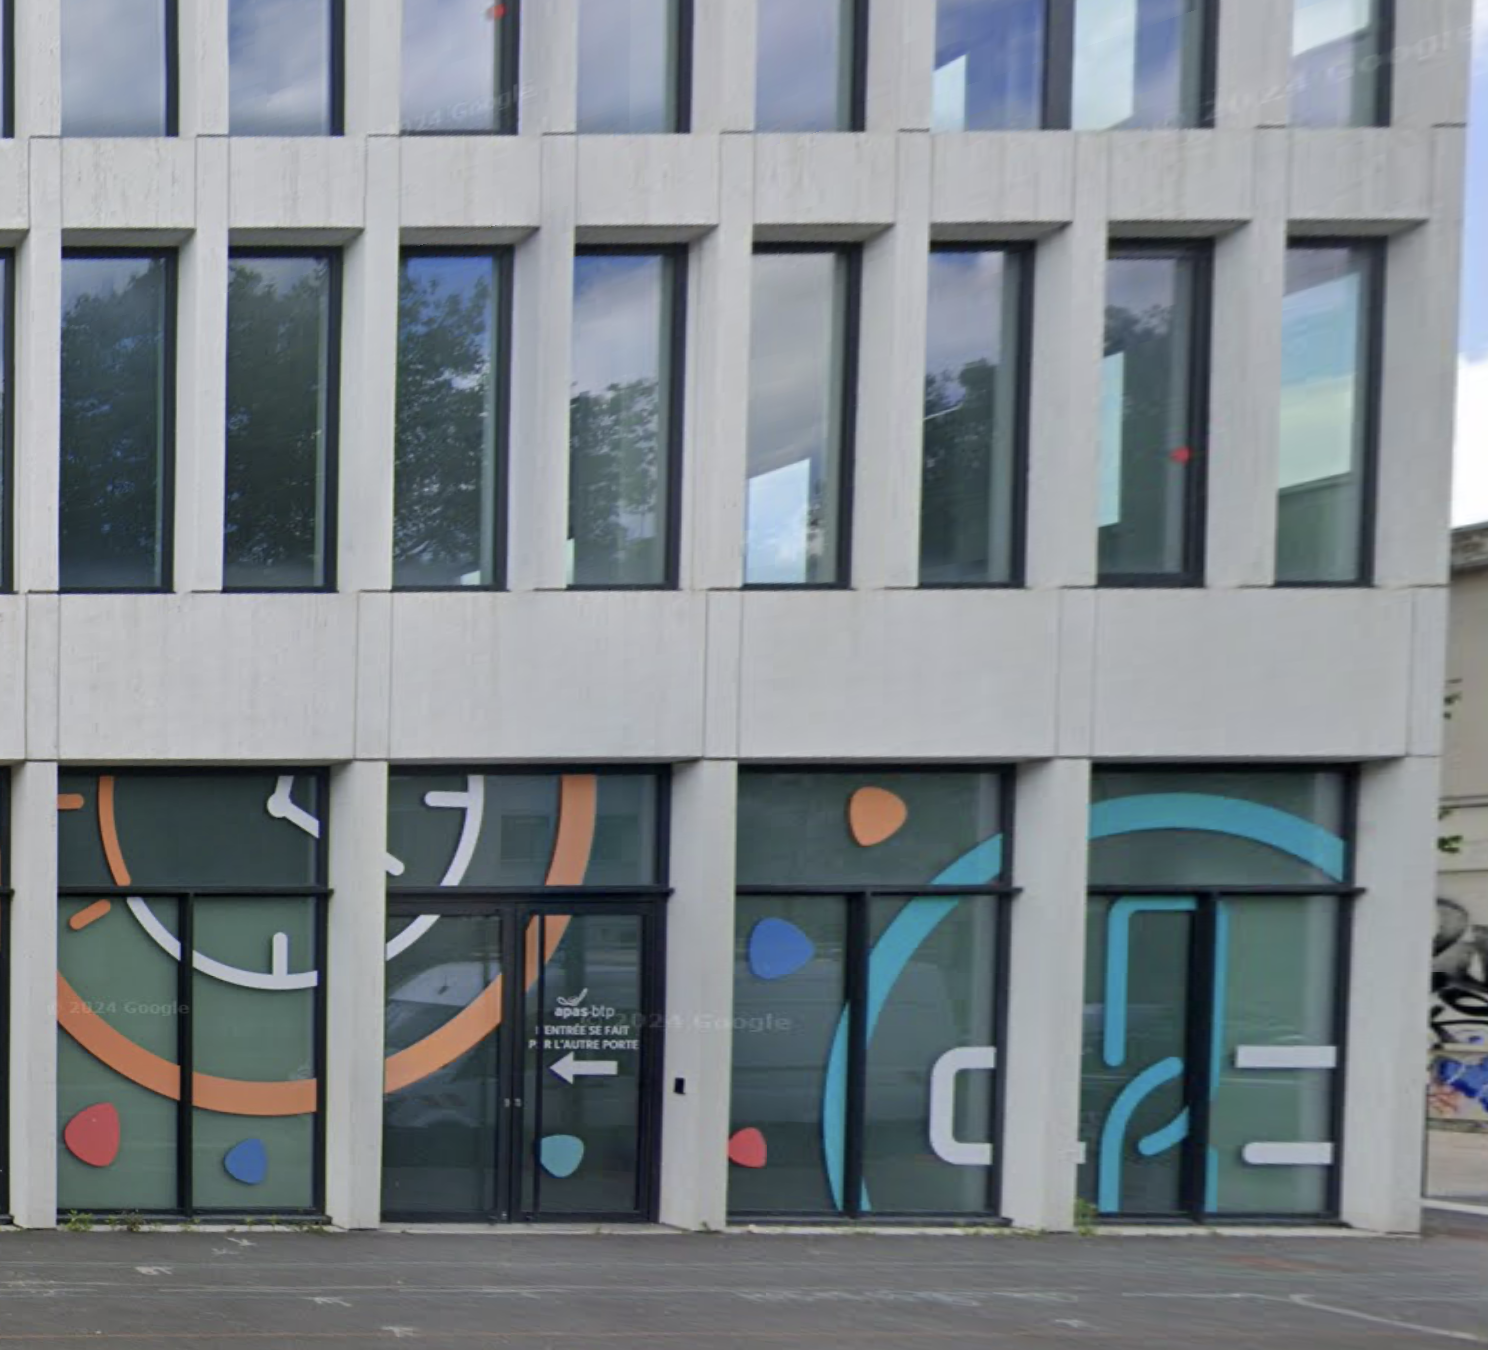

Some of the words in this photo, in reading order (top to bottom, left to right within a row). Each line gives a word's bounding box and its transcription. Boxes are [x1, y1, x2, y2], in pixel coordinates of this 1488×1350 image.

[554, 1005, 615, 1019] apas-btp
[588, 1025, 602, 1035] SE
[604, 1025, 630, 1035] FAIT
[554, 1039, 600, 1049] L'AUTRE
[602, 1039, 639, 1049] PORTE
